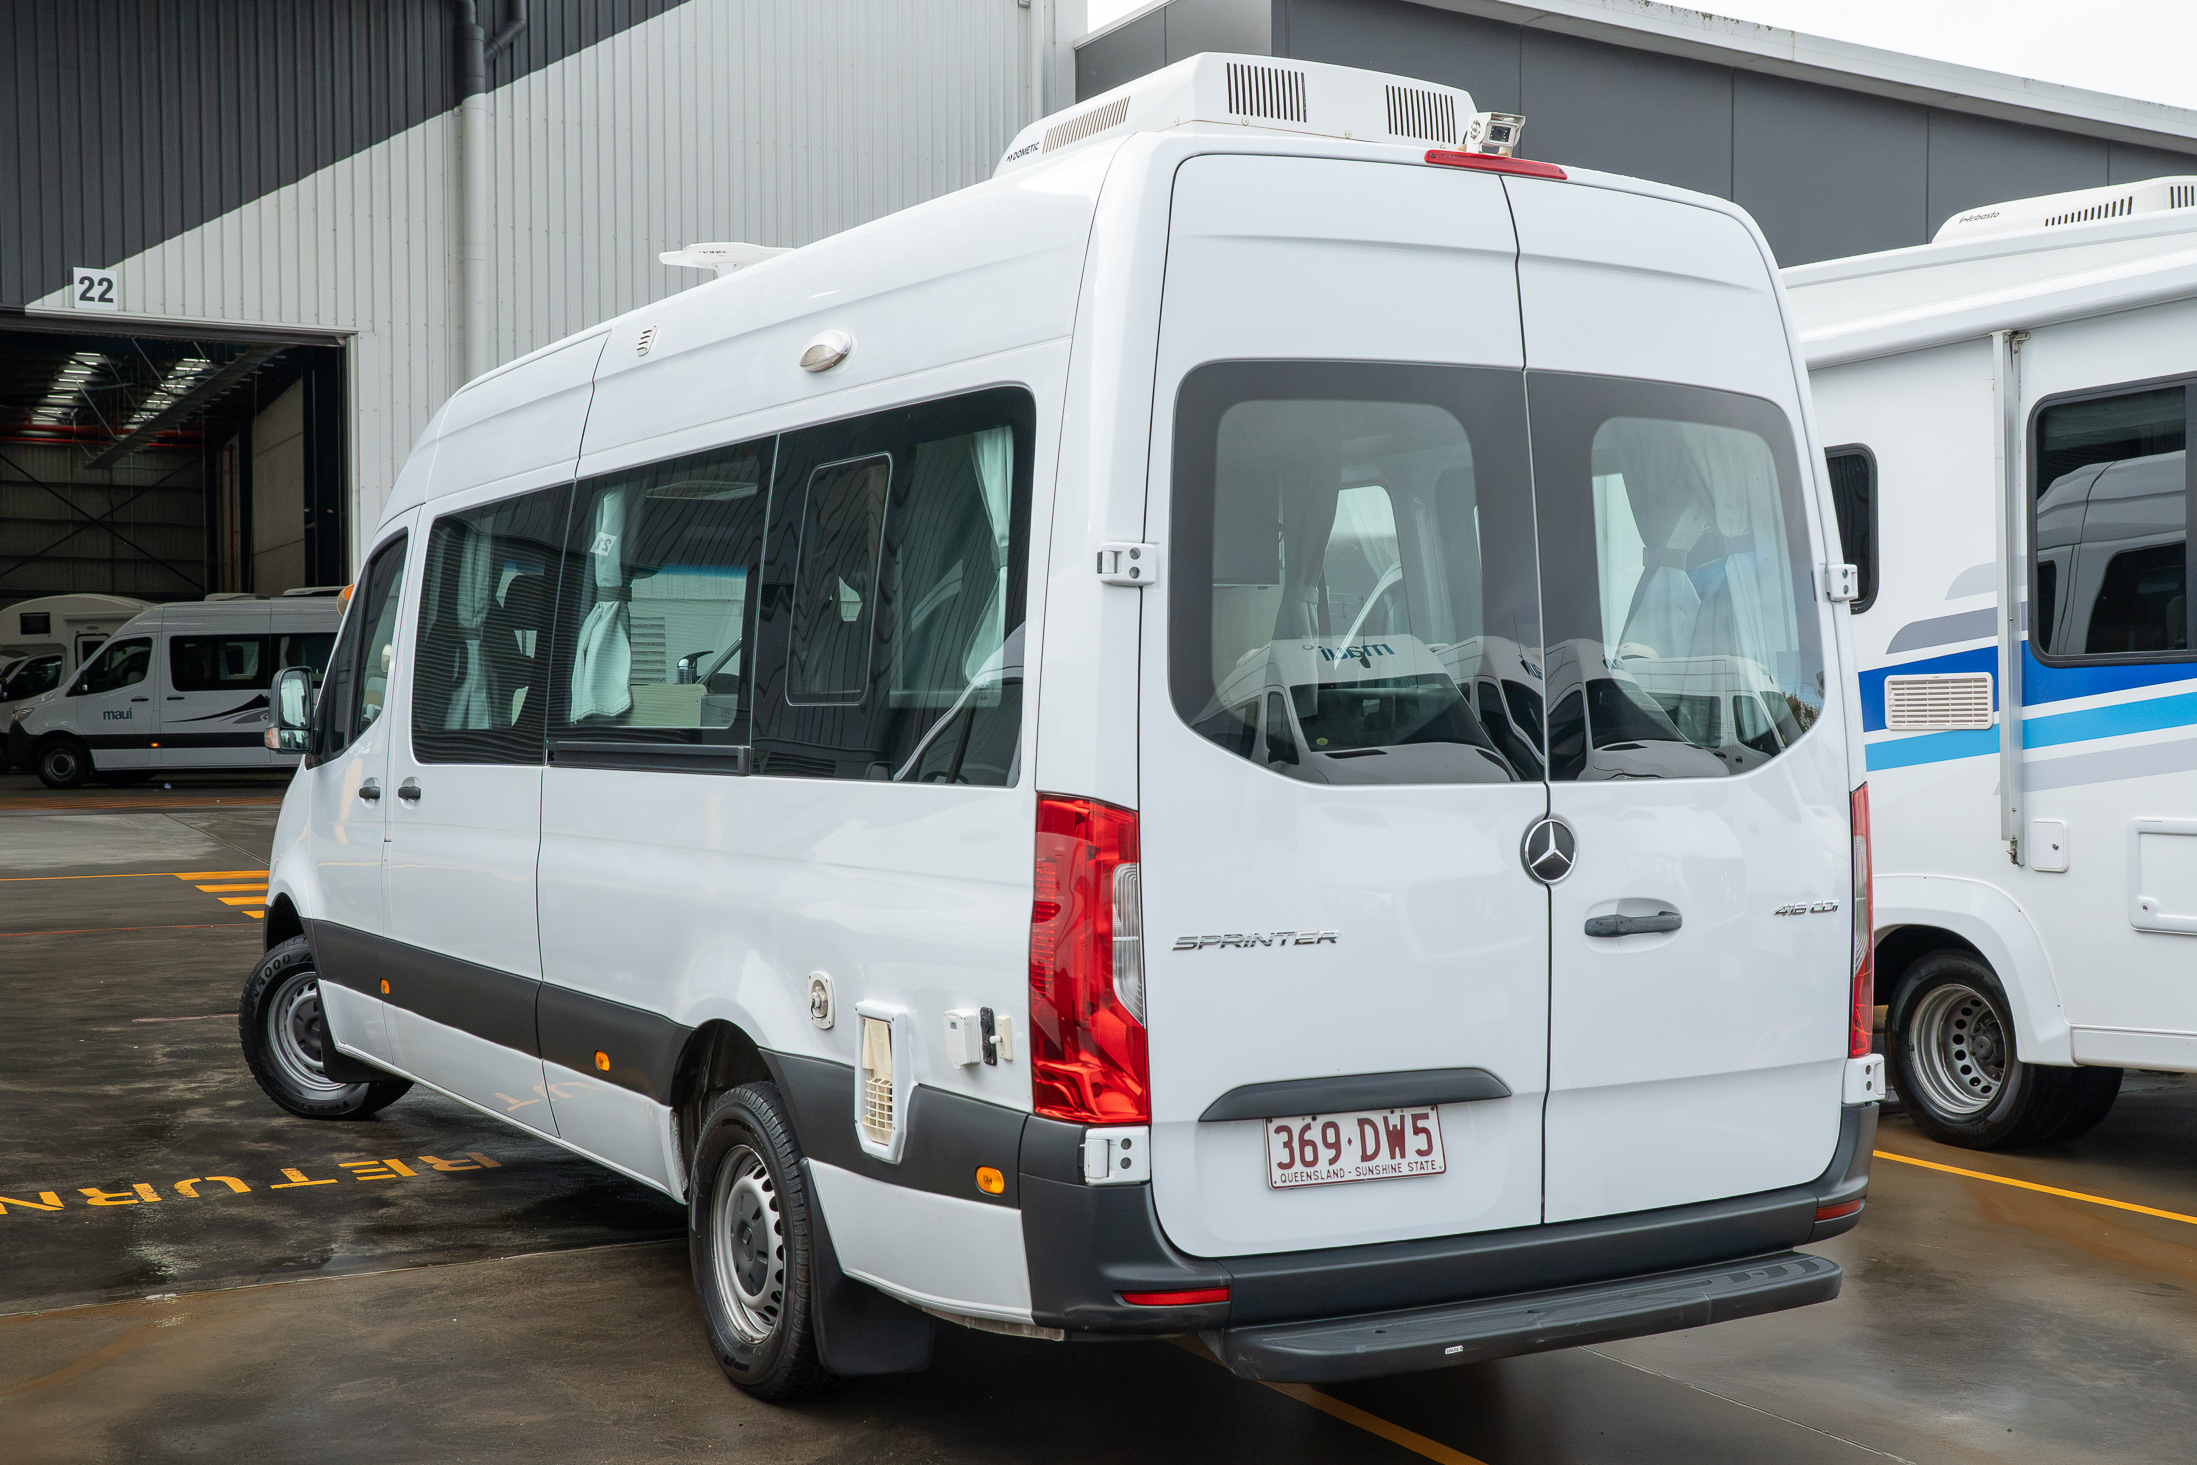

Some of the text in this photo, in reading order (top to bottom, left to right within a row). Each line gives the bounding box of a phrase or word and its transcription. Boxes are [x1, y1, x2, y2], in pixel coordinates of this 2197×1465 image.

[1012, 141, 1040, 161] DOMETIC
[1958, 211, 2000, 224] Webasto
[78, 275, 114, 303] 22
[103, 706, 133, 720] maui
[1171, 928, 1341, 952] SPRINTER
[1280, 1167, 1345, 1183] QUEENSLAND
[1355, 1162, 1403, 1177] SUNSHINE
[1407, 1159, 1437, 1173] STATE
[0, 1152, 502, 1215] RETURN
